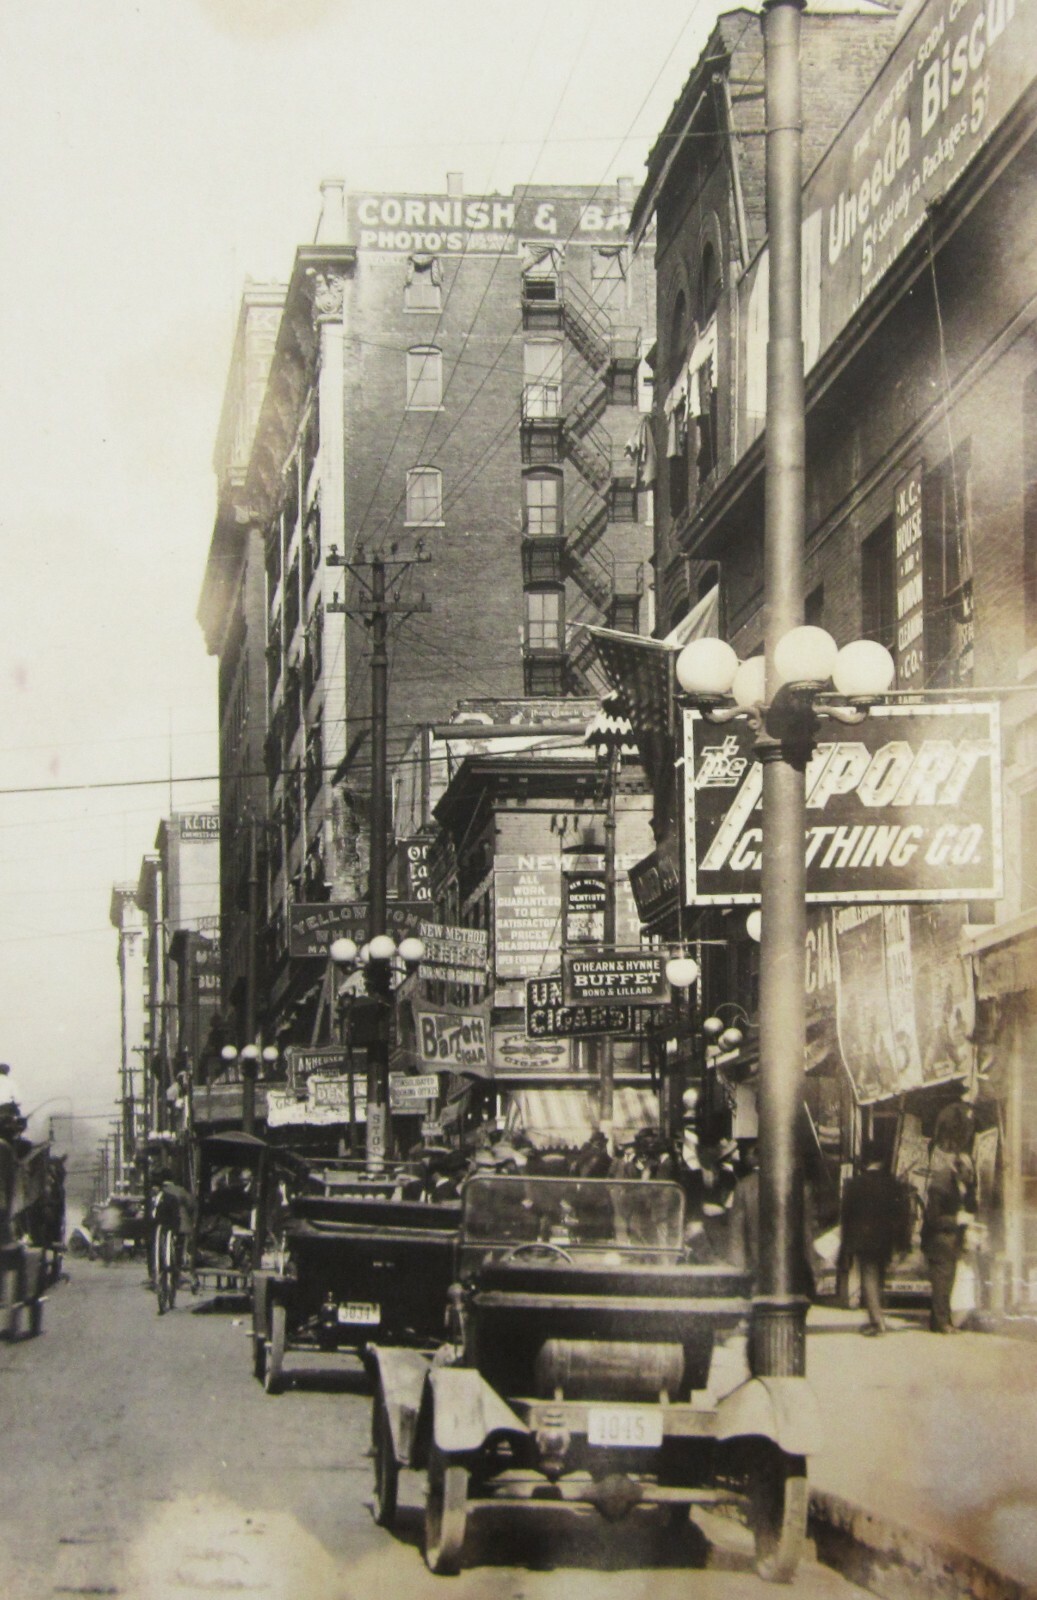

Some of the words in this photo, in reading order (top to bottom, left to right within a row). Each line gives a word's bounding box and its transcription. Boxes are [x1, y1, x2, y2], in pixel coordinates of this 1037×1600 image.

[828, 117, 911, 265] Uneeda
[357, 200, 515, 229] CORNISH
[534, 204, 558, 234] &
[360, 231, 463, 251] PHOTO'S
[729, 823, 919, 871] CTHING
[924, 823, 982, 869] CO.
[518, 856, 573, 871] NEW
[519, 875, 539, 885] ALL
[513, 886, 546, 896] WORK
[498, 896, 561, 907] GUARANTEED
[514, 907, 529, 917] TO
[530, 907, 545, 917] BE
[419, 923, 443, 938] NEW
[445, 926, 487, 944] METHOD
[510, 930, 549, 940] PRICES
[573, 961, 615, 973] O'HEARN
[616, 960, 624, 971] &
[574, 972, 661, 987] BUFFET
[608, 988, 615, 996] &
[617, 987, 653, 996] LILLARD
[530, 1005, 625, 1034] CIGARS
